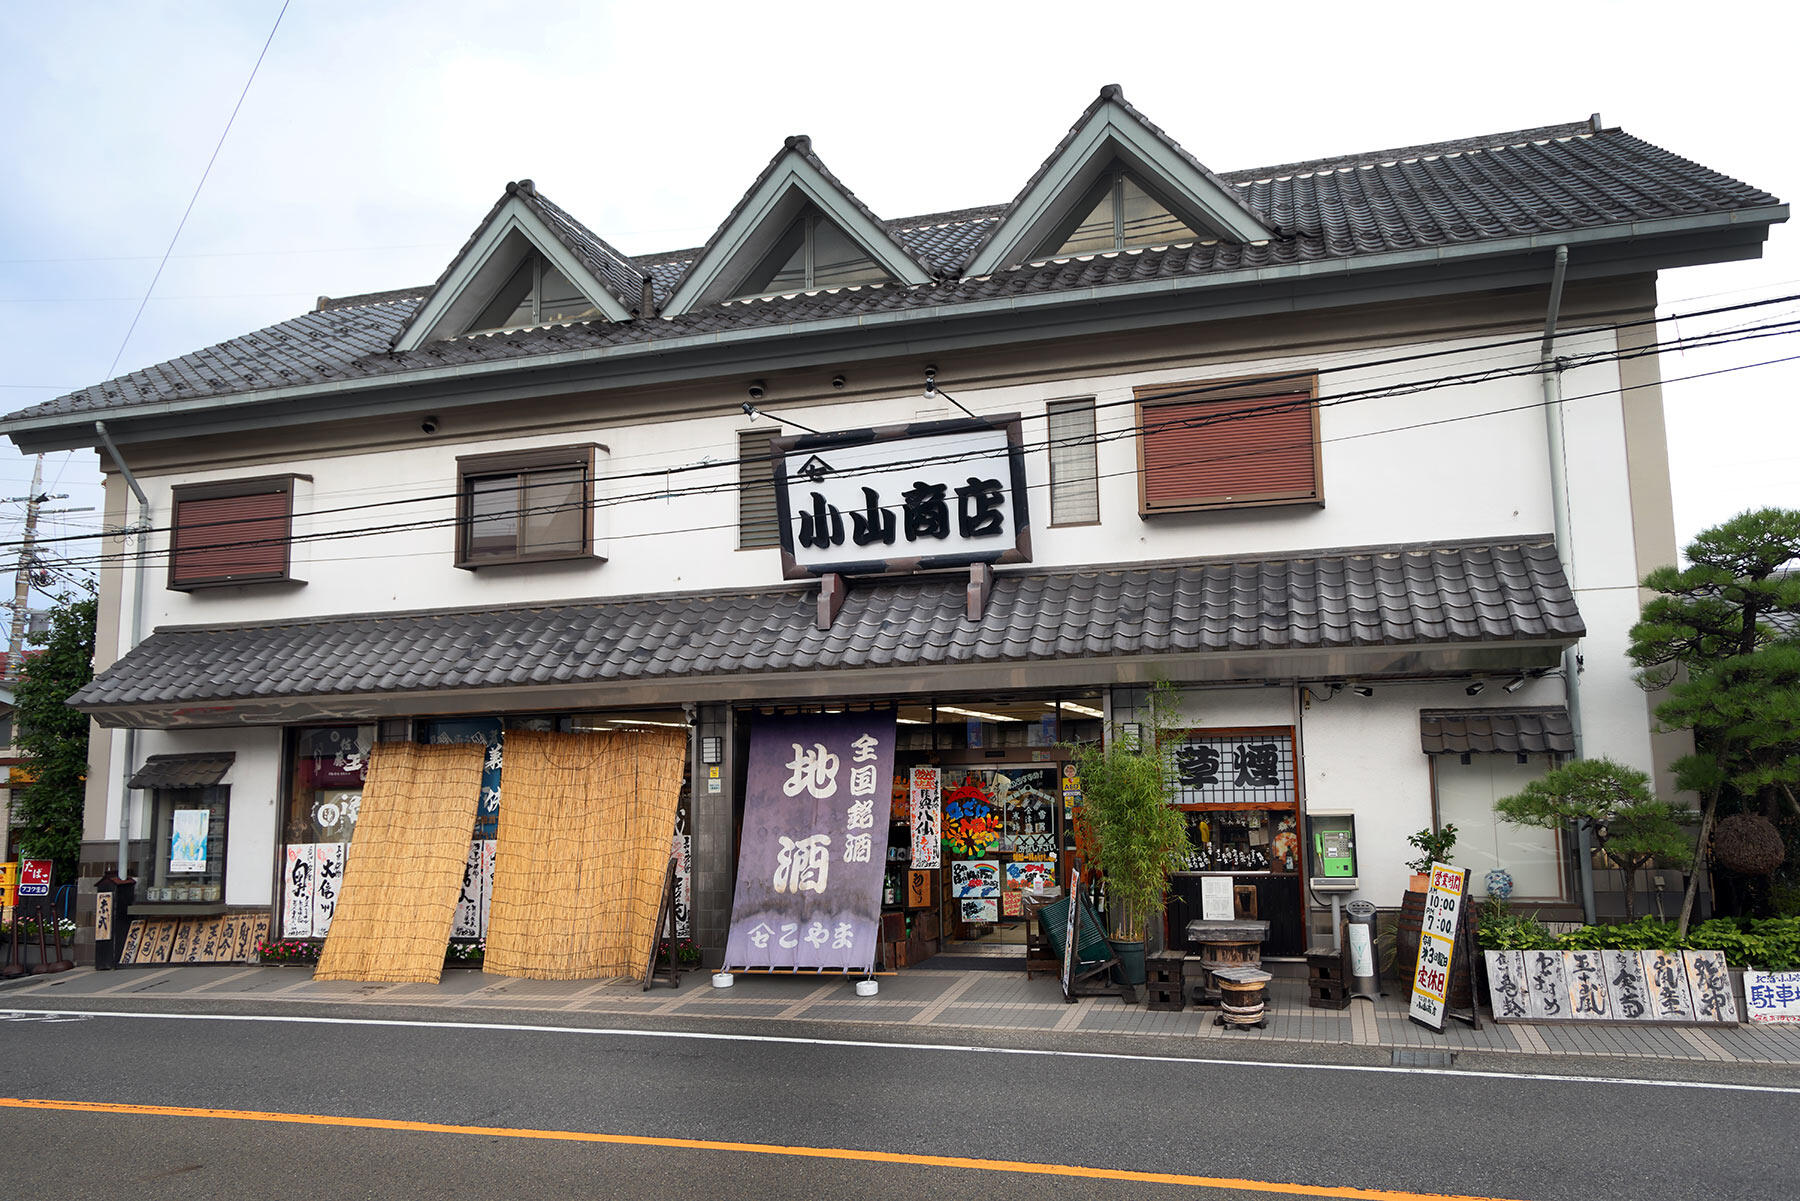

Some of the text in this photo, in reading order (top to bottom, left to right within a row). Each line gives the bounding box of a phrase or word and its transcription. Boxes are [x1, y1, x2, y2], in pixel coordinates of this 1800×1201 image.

[799, 476, 1004, 548] 小山商店
[843, 733, 879, 863] 全国銘酒
[773, 743, 840, 895] 地酒
[24, 861, 48, 883] たばこ
[1434, 871, 1461, 892] 営業時間
[1430, 895, 1455, 912] 10:00
[779, 921, 853, 949] こやま
[1427, 915, 1452, 933] 7:00
[1418, 965, 1445, 992] 定休日
